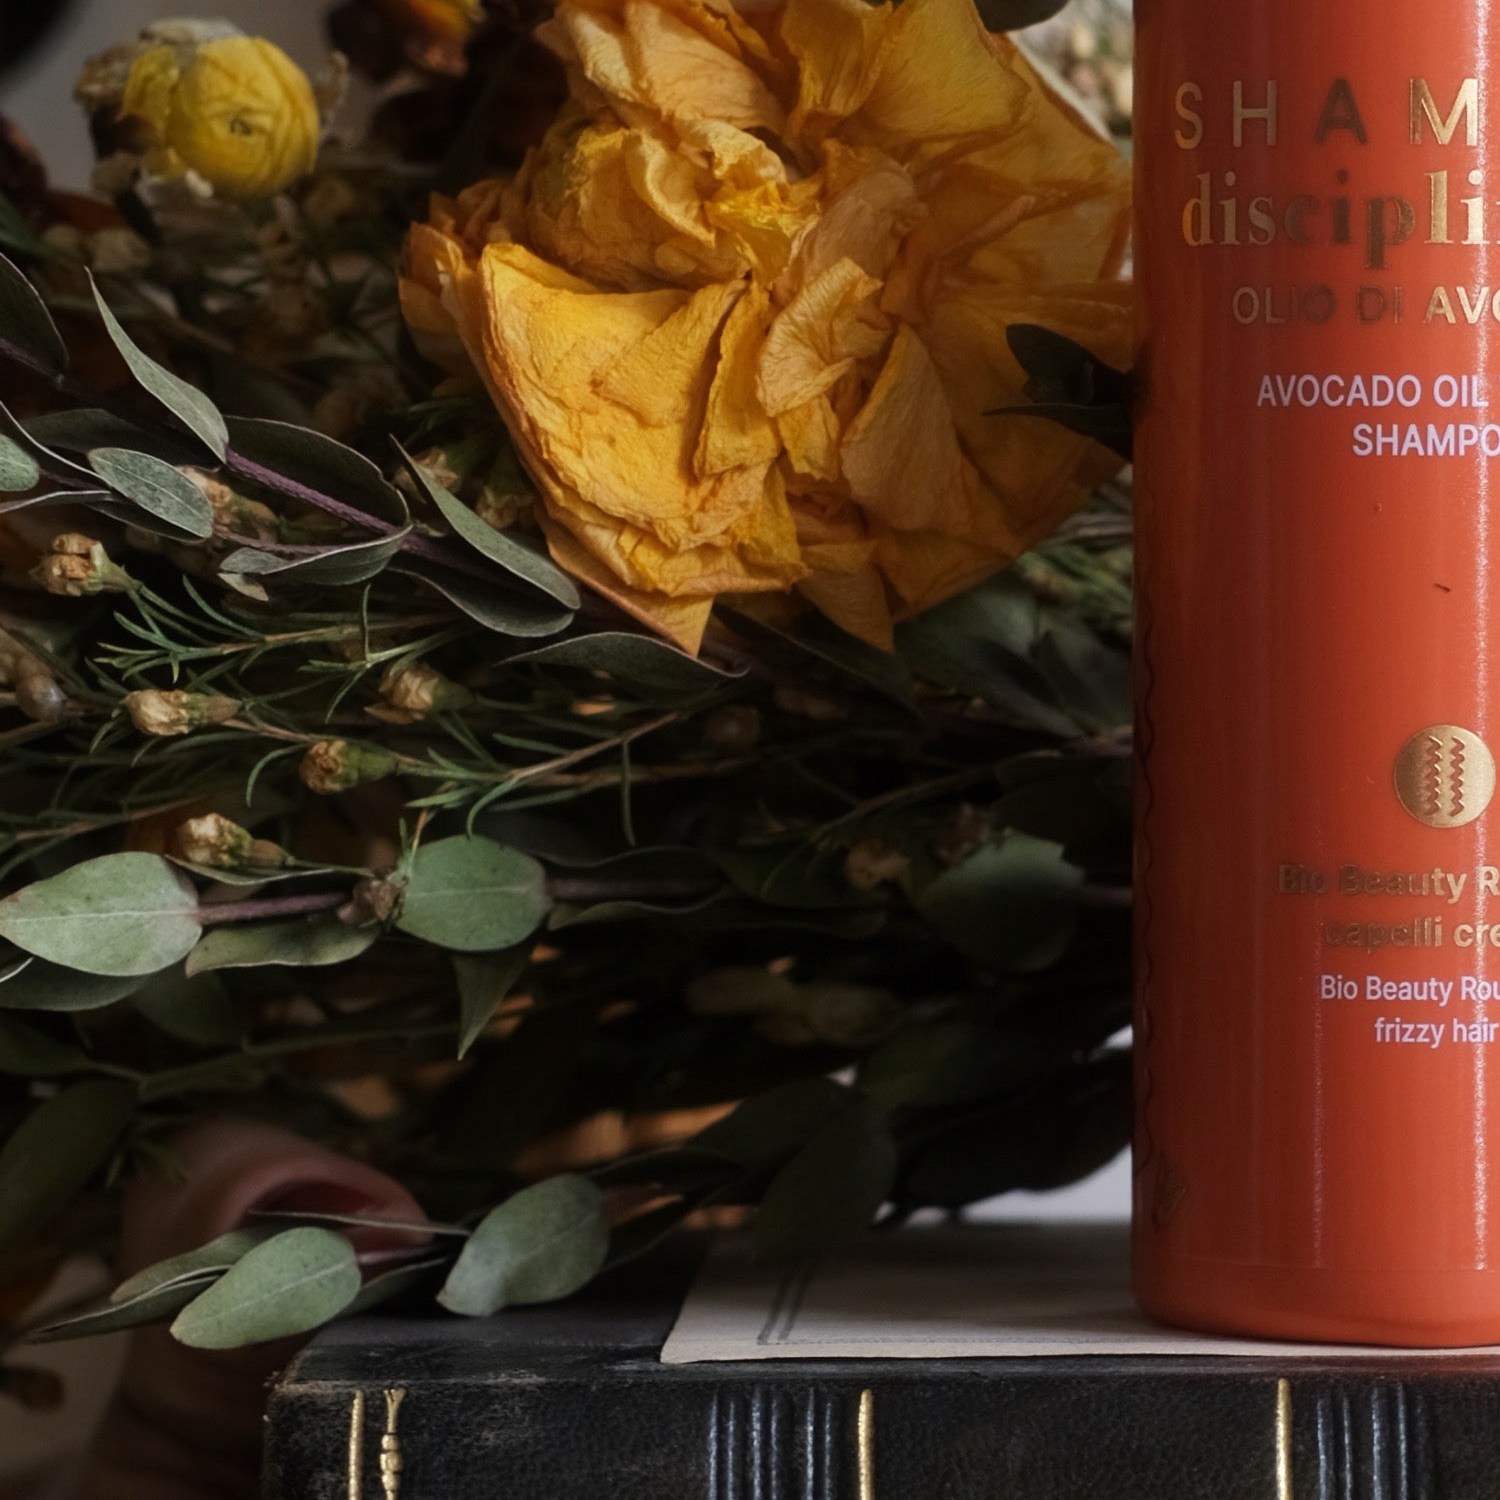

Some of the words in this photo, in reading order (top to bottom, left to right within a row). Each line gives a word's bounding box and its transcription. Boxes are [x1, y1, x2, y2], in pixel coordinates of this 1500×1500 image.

[1232, 285, 1336, 326] OLIO
[1257, 374, 1422, 408] AVOCADO
[1433, 374, 1488, 408] OIL
[1277, 863, 1325, 895] Bio
[1339, 863, 1467, 904] Beauty
[1322, 917, 1442, 955] capelli
[1320, 975, 1359, 1001] Bio
[1366, 975, 1454, 1007] Beauty
[1374, 1018, 1445, 1049] frizzy
[1453, 1018, 1499, 1044] hair
